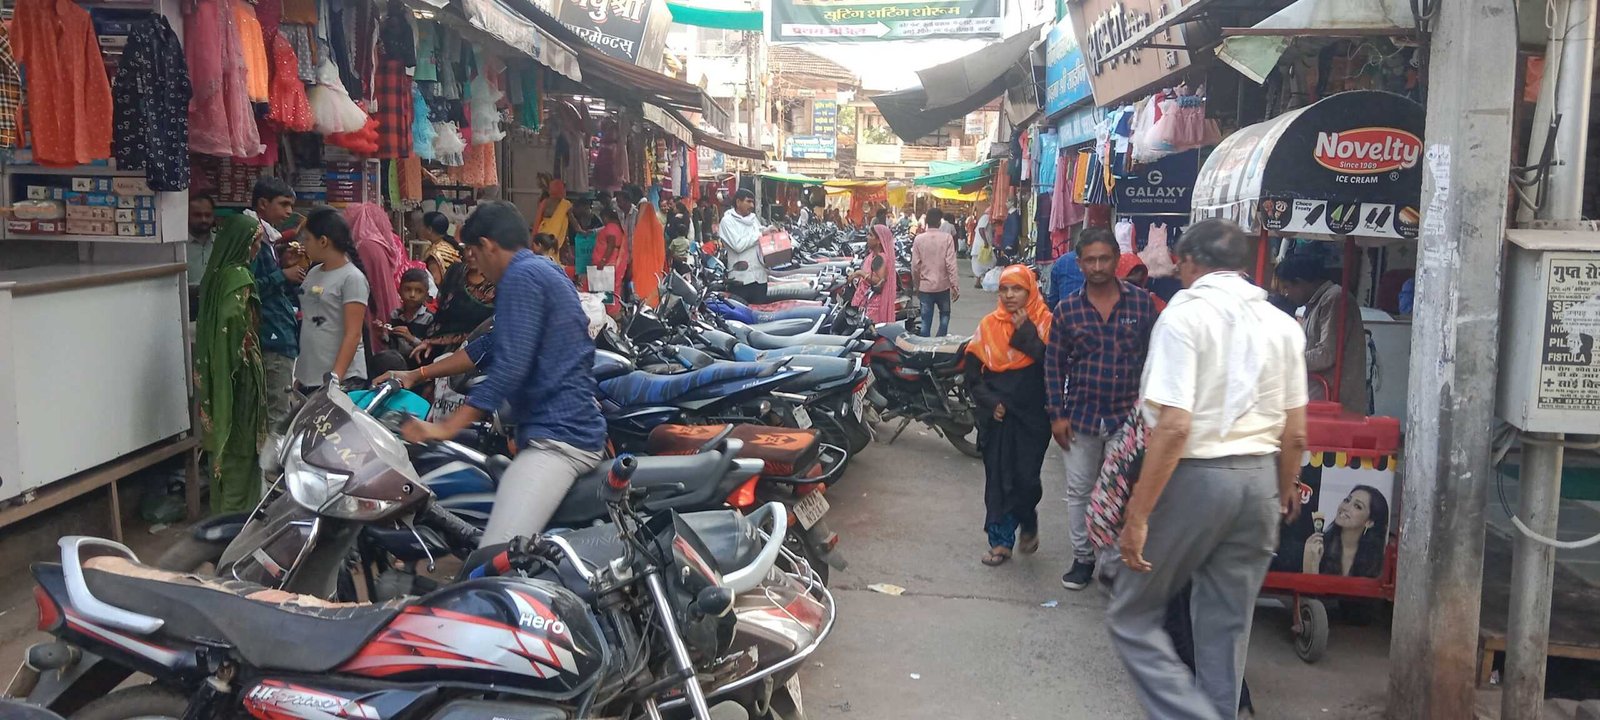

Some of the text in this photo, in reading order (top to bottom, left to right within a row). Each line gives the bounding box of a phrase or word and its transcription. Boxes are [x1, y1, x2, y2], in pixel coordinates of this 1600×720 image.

[824, 6, 960, 22] सूटिंग शर्टिंग शोरूम
[1315, 131, 1419, 169] Novelty
[1336, 175, 1378, 184] ICE CREAM
[1125, 186, 1186, 197] GALAXY
[1553, 265, 1581, 283] गुप्त
[1548, 352, 1586, 363] FISTULA
[519, 612, 565, 635] Hero
[249, 685, 280, 700] HF
